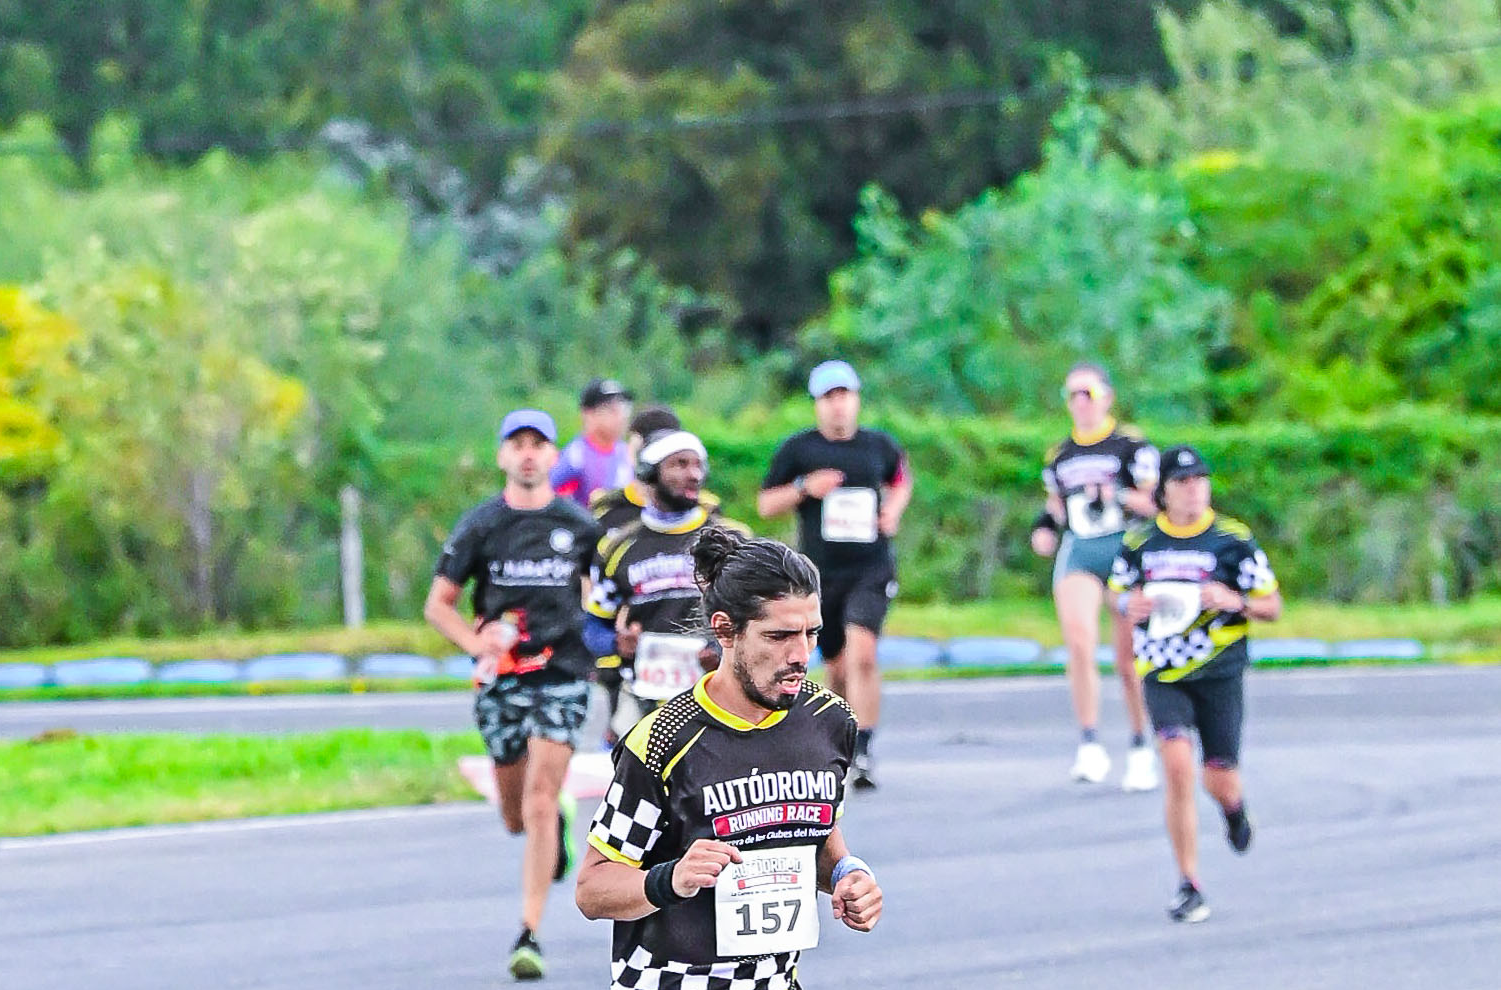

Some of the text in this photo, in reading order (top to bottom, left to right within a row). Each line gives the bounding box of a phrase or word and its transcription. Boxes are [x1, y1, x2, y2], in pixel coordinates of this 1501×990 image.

[702, 767, 837, 816] AUTÓDROMO
[728, 803, 823, 832] RUNNING RACE
[766, 828, 793, 841] Clubes
[793, 828, 807, 837] del
[736, 899, 801, 936] 157
